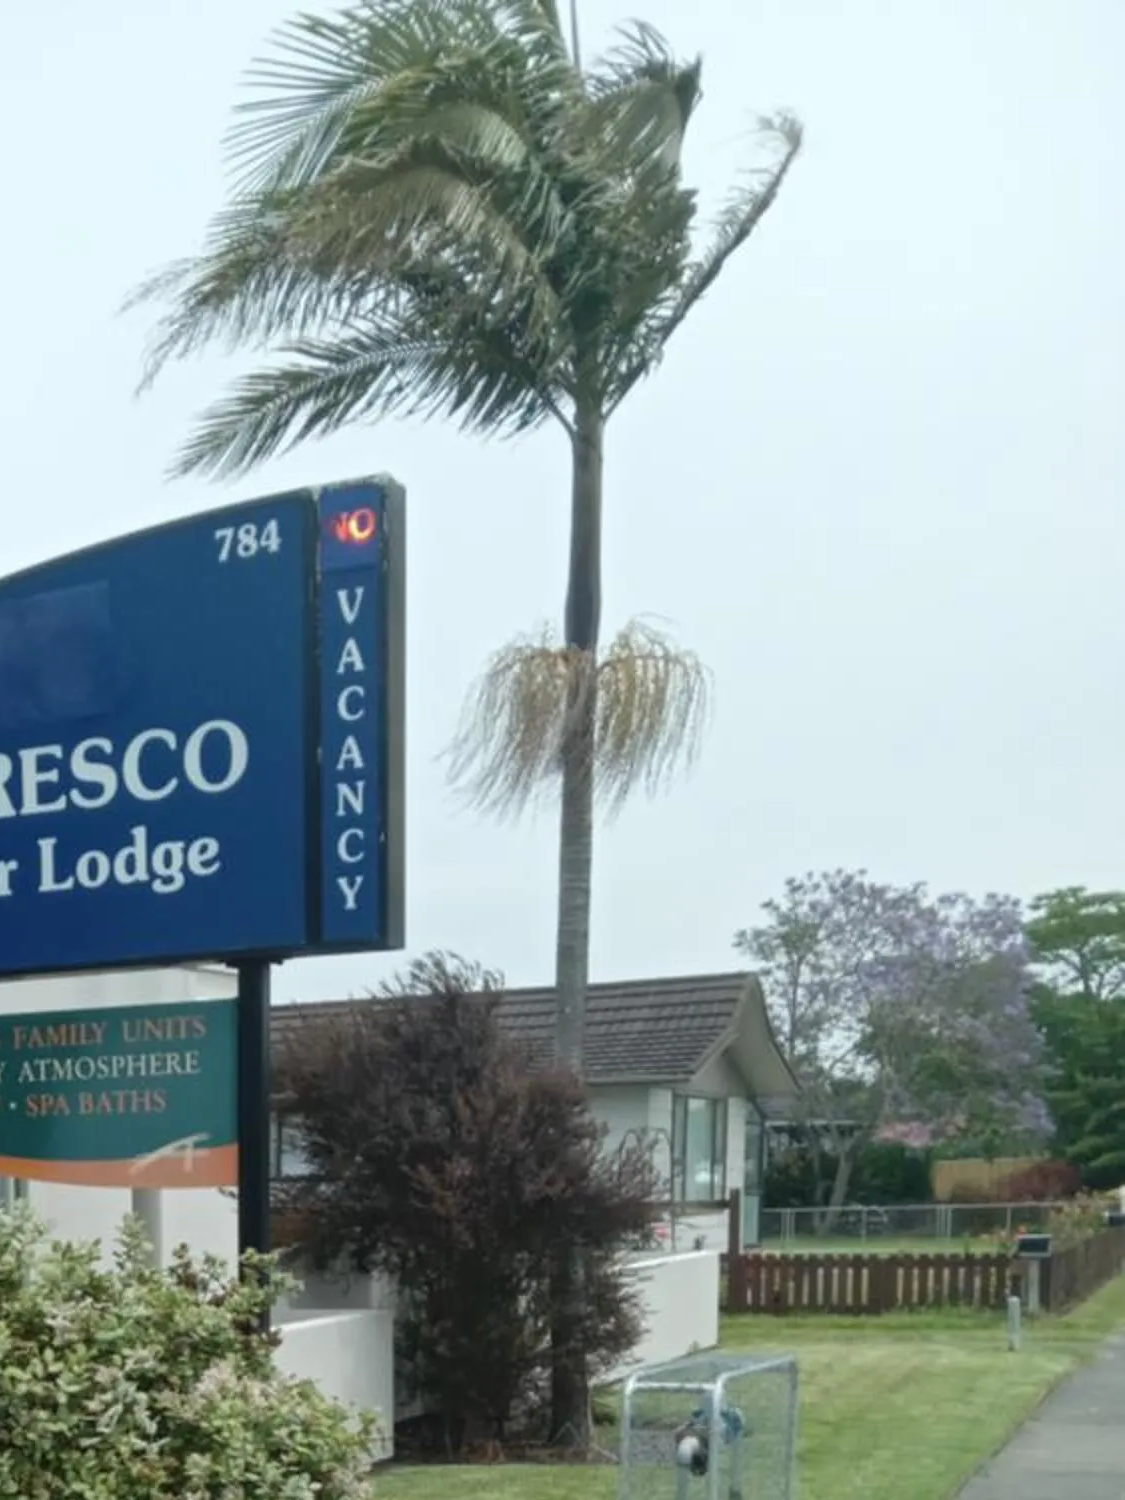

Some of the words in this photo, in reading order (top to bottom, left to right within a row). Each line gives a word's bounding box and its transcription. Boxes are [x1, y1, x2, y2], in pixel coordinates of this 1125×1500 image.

[214, 517, 282, 563] 784
[334, 585, 366, 910] VACANCY
[37, 825, 221, 894] Lodge
[14, 1021, 107, 1050] FAMILY
[122, 1015, 207, 1042] UNITS
[18, 1051, 200, 1084] ATMOSPHERE
[24, 1092, 72, 1118] SPA
[78, 1088, 167, 1115] BATHS
